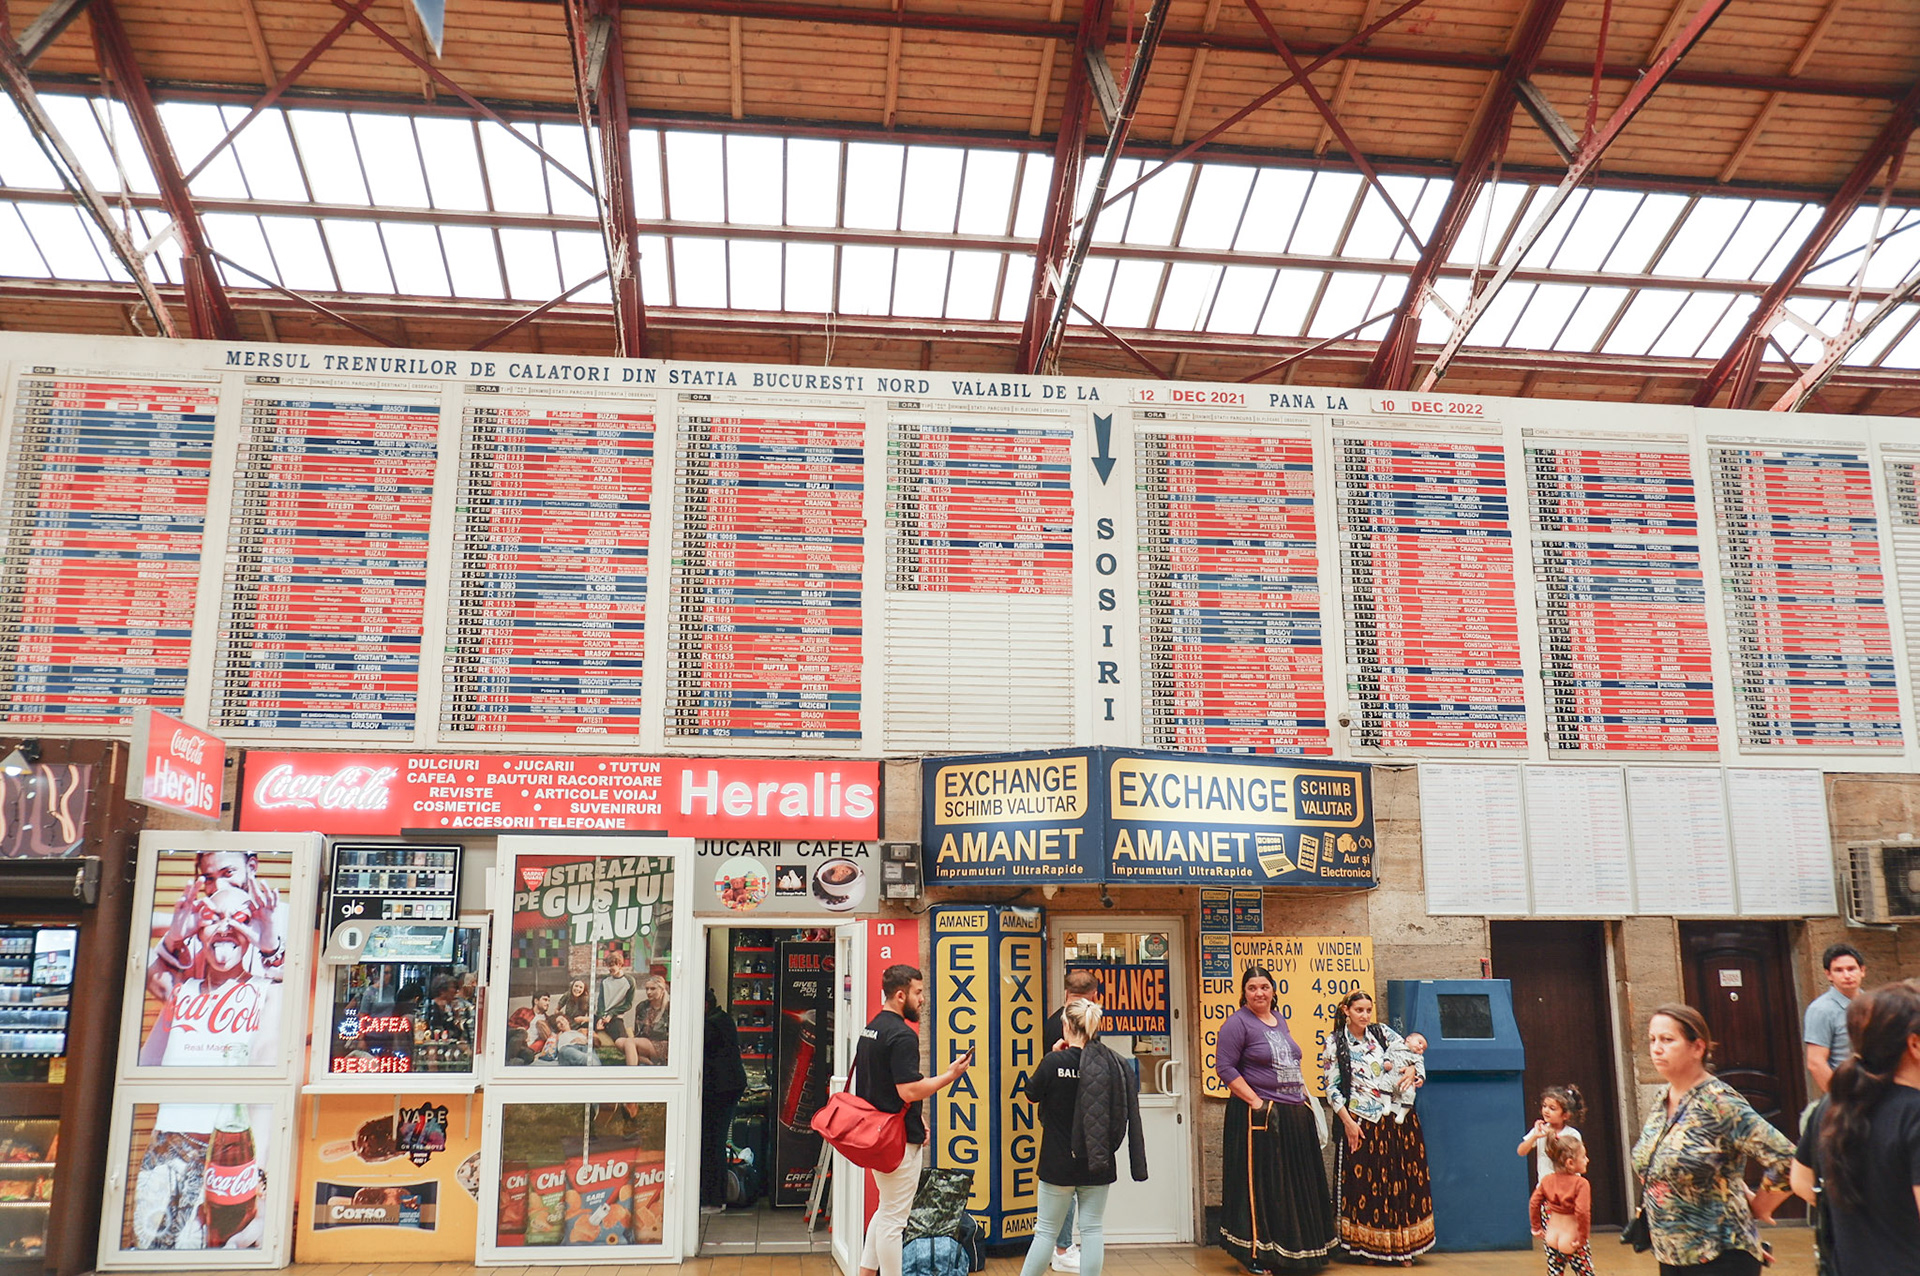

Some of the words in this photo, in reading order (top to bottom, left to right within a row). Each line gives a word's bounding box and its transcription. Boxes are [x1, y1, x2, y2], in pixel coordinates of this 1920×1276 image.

[226, 351, 310, 368] MERSUL
[324, 355, 457, 375] TRENURILOR
[470, 362, 496, 377] DE
[509, 363, 609, 382] CALATORI
[622, 368, 657, 383] DIN
[669, 370, 737, 386] STATIA
[753, 373, 863, 391] BUCURESTI
[877, 378, 930, 393] NORD
[952, 381, 1031, 397] VALABIL
[1043, 385, 1067, 399] DE
[1078, 386, 1100, 401] LA
[1138, 390, 1154, 401] 12
[1172, 390, 1206, 403] DEC
[1210, 391, 1245, 405] 2021
[1269, 393, 1315, 409] PANA
[1326, 396, 1348, 410] LA
[1380, 400, 1395, 412] 10
[1411, 401, 1444, 414] DEC
[1448, 402, 1483, 415] 2022
[1096, 517, 1120, 721] SOSIRI
[357, 634, 383, 642] BRASOV
[351, 721, 379, 729] BRASOV
[408, 759, 479, 771] DULCIURI
[514, 760, 575, 772] JUCARII
[610, 762, 661, 773] TUTUN
[153, 755, 214, 811] Heralis
[407, 772, 456, 784] CAFEA
[486, 774, 553, 786] BAUTURI
[557, 774, 662, 787] RACORITOARE
[945, 764, 1078, 798] EXCHANGE
[429, 787, 493, 799] REVISTE
[534, 788, 608, 800] ARTICOLE
[613, 789, 657, 801] VOIAJ
[680, 769, 874, 819] Heralis
[1119, 770, 1288, 813] EXCHANGE
[1300, 780, 1351, 797] SCHIMB
[413, 800, 501, 813] COSMETICE
[570, 802, 662, 815] SUVENIRURI
[945, 798, 1003, 818] SCHIMB
[1007, 795, 1077, 815] VALUTAR
[1301, 800, 1352, 816] VALUTAR
[452, 816, 534, 828] ACCESORII
[539, 816, 625, 829] TELEFOANE
[697, 840, 781, 857] JUCARII
[796, 841, 870, 858] CAFEA
[936, 828, 1084, 864] AMANET
[1112, 828, 1250, 863] AMANET
[1343, 853, 1361, 864] Aur
[936, 864, 1006, 879] Împrumuturi
[1013, 864, 1084, 877] UltraRapide
[1112, 865, 1182, 877] Împrumuturi
[1189, 866, 1253, 878] UltraRapide
[1320, 866, 1372, 878] Electronice
[514, 891, 541, 912] PE
[939, 915, 985, 928] AMANET
[1002, 915, 1039, 929] AMANET
[1148, 943, 1164, 951] BGS
[1234, 939, 1303, 956] CUMPĂRĂM
[1317, 942, 1362, 956] VINDEM
[788, 954, 821, 969] HELL
[1267, 958, 1297, 973] BUY)
[1309, 958, 1333, 973] (WE
[1336, 958, 1370, 973] SELL)
[1069, 968, 1166, 1012] CHANGE
[1203, 979, 1234, 994] EUR
[1312, 978, 1360, 998] 4,900
[1204, 1004, 1235, 1020] USD
[1313, 1004, 1337, 1022] 4,9
[359, 1015, 411, 1034] CAFEA
[1115, 1015, 1166, 1032] VALUTAR
[184, 1044, 203, 1052] Real
[948, 944, 977, 1198] EXCHANG
[1010, 944, 1036, 1198] EXCHANGE
[1206, 1075, 1229, 1091] CA
[402, 1110, 447, 1124] VAPE
[576, 1159, 629, 1186] Chio
[331, 1205, 387, 1220] Corso
[1005, 1217, 1038, 1234] AMANE
